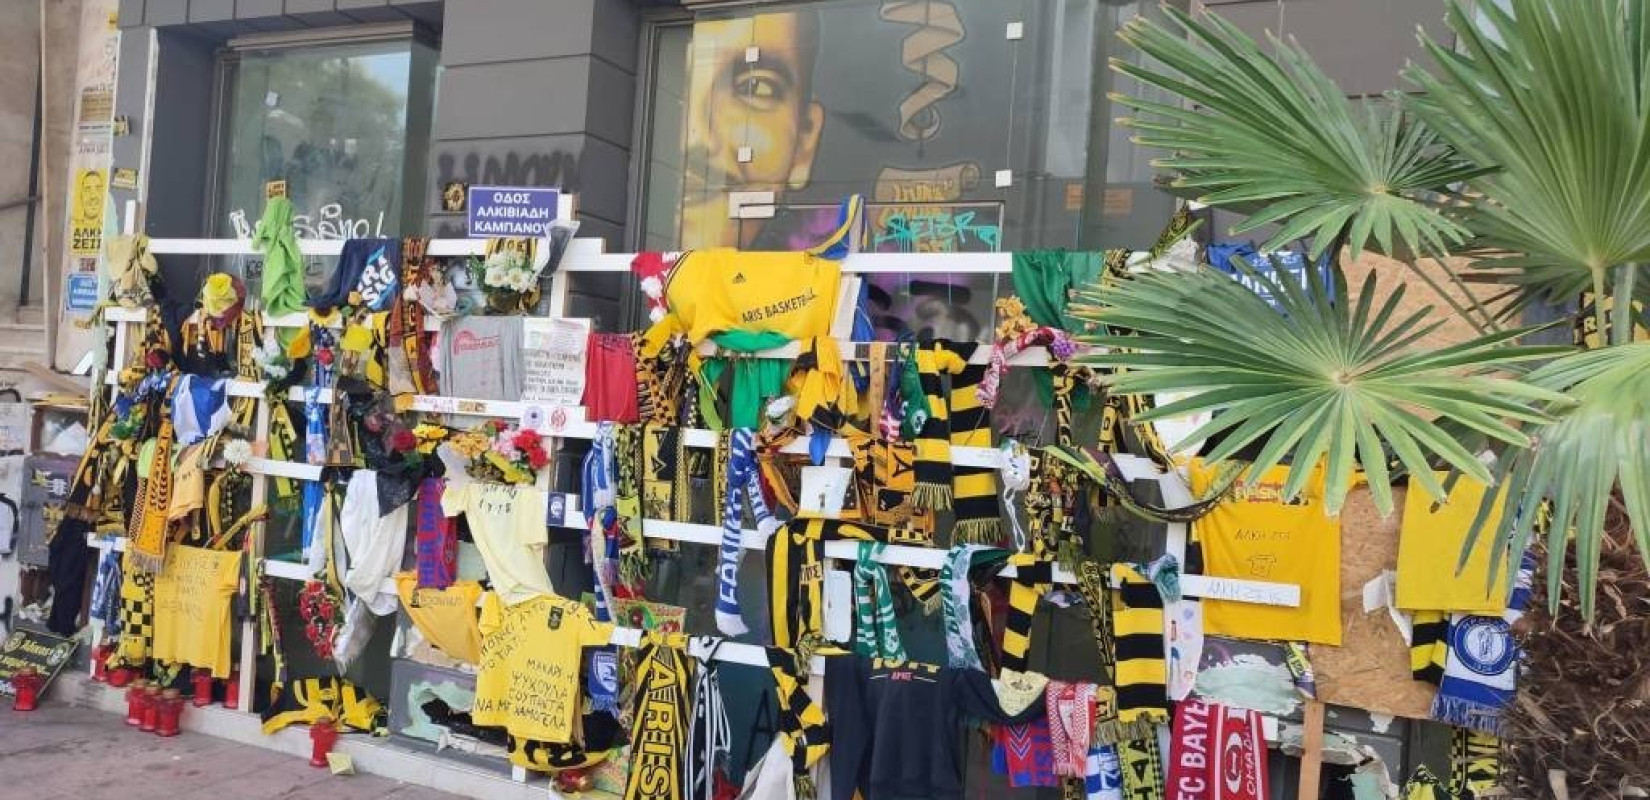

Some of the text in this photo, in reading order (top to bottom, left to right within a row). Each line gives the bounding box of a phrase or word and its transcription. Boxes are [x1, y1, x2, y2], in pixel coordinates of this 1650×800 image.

[493, 192, 530, 204] ΟΔΟΣ
[476, 206, 549, 219] ΑΛΚΙΒΙΑΔΗ
[742, 307, 763, 323] ARIS
[640, 656, 676, 797] ARIS
